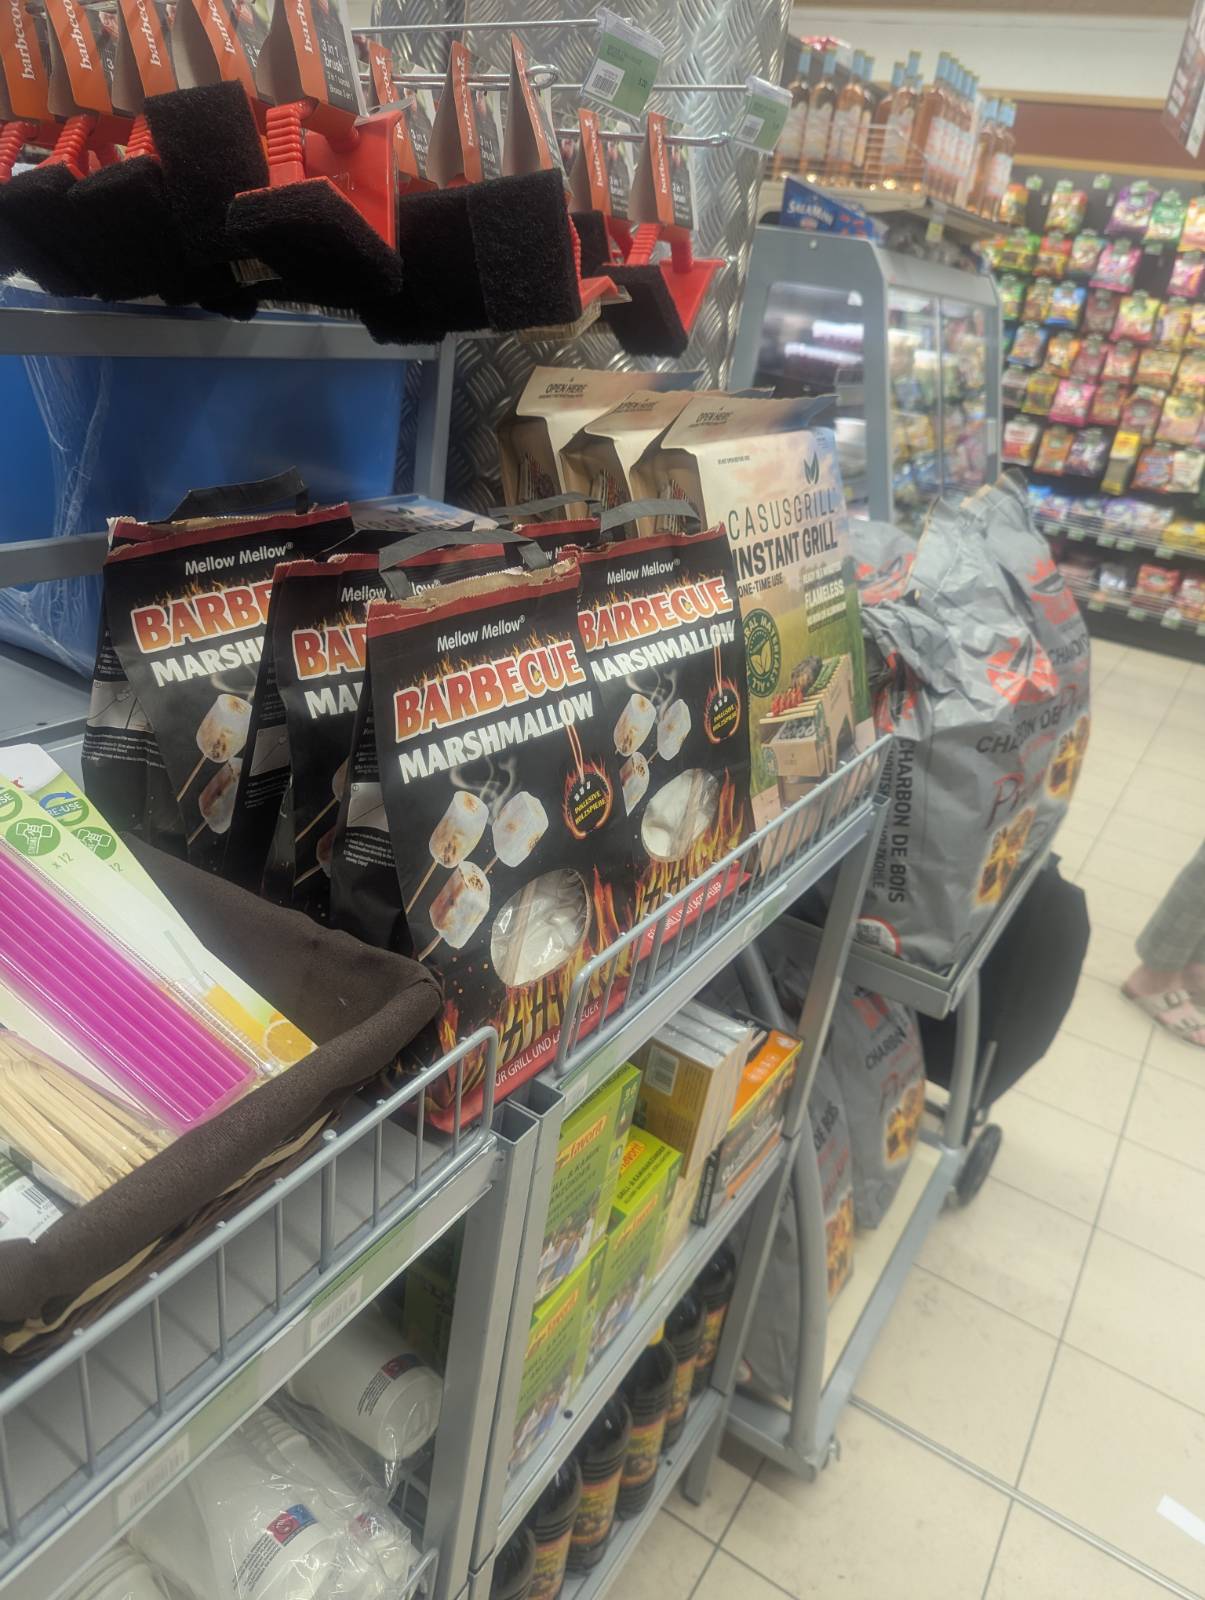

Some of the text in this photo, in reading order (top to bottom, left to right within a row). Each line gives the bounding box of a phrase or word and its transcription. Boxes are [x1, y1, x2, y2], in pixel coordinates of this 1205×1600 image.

[324, 54, 344, 74] brush
[727, 488, 836, 541] CASUSGRILL
[802, 520, 838, 559] GRILL
[185, 554, 236, 577] Mellow
[606, 569, 639, 586] Mellow
[772, 573, 784, 587] USE
[341, 585, 388, 603] Mellow
[577, 576, 735, 653] BARBECUE
[437, 626, 478, 653] Mellow
[394, 639, 588, 743] BARBECUE
[398, 690, 595, 785] MARSHMALLOW
[888, 739, 916, 904] CHARBON DE BOIS
[507, 1053, 533, 1076] GRILL
[533, 1038, 551, 1058] UND
